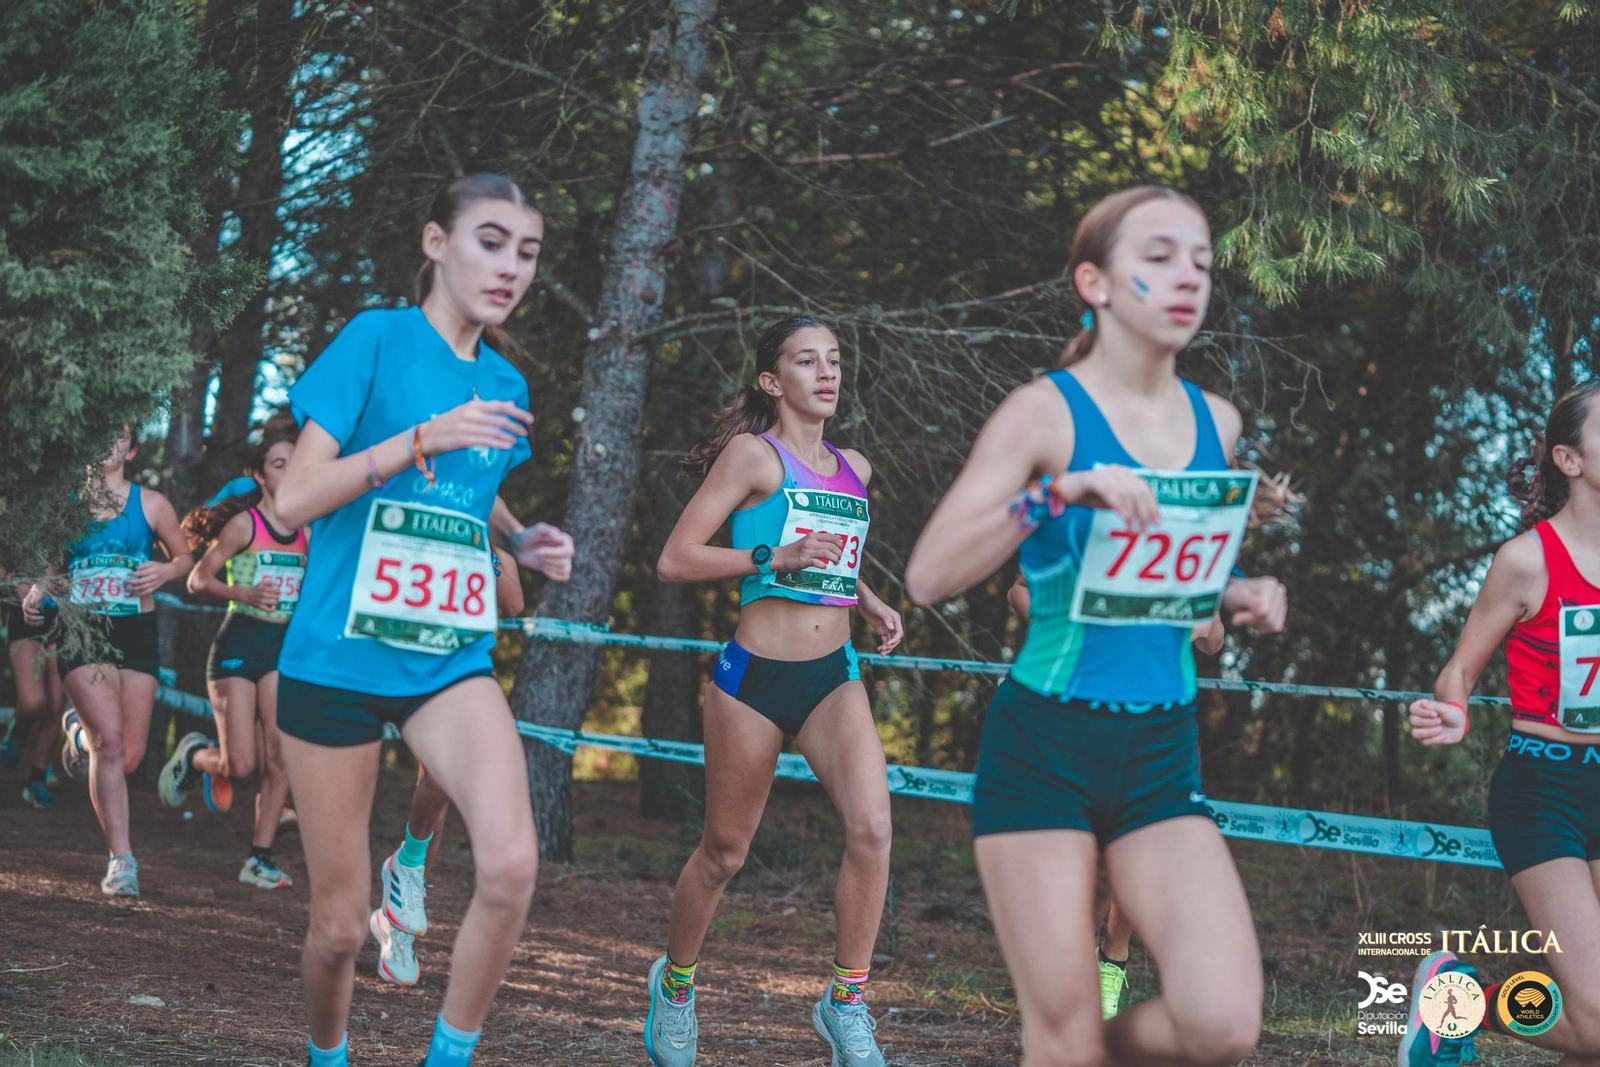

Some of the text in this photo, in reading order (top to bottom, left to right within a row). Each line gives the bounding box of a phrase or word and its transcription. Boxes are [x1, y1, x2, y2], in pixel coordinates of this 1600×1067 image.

[815, 494, 853, 511] ITÁLICA
[1105, 530, 1232, 583] 7267
[370, 558, 487, 616] 5318
[1507, 734, 1572, 761] PRO
[1229, 820, 1264, 834] Sevilla
[1342, 833, 1380, 848] Sevilla
